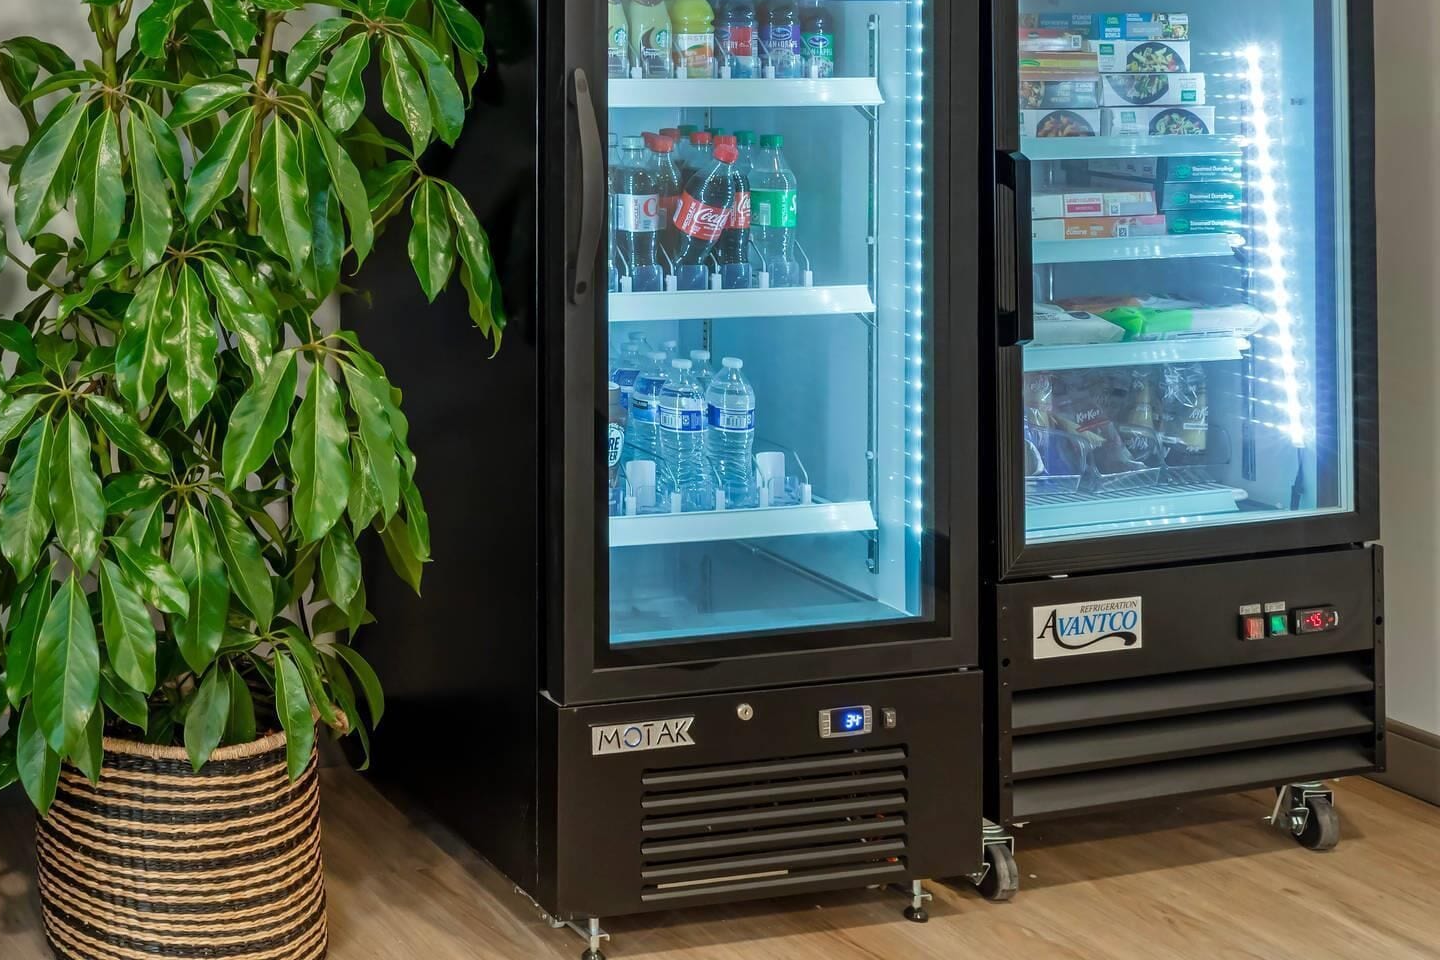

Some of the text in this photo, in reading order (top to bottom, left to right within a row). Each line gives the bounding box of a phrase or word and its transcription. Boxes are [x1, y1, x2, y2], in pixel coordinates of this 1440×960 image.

[1079, 599, 1138, 615] REFRIGERATION
[1036, 608, 1139, 641] AVANTCO
[845, 714, 863, 729] 34
[597, 719, 690, 751] MOTAK
